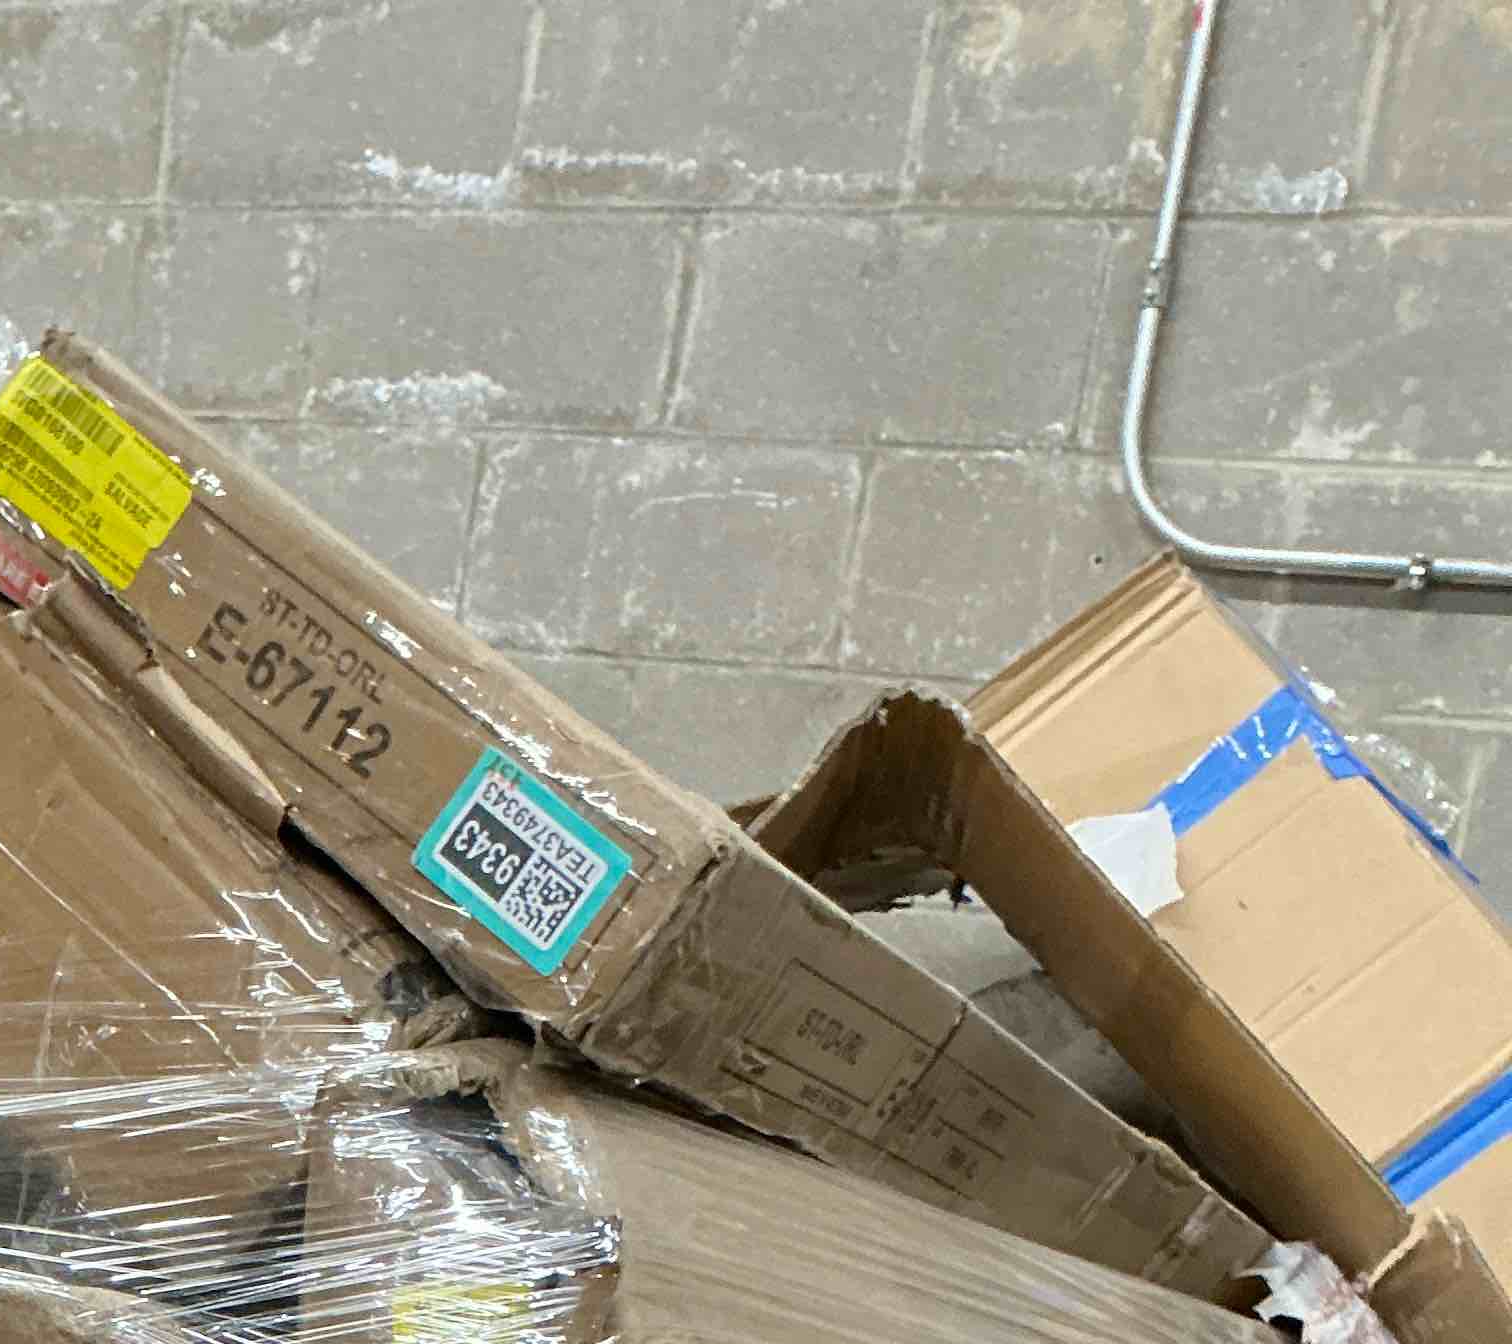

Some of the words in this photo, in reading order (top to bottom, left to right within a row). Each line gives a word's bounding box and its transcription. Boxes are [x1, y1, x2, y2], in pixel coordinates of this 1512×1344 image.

[195, 601, 392, 780] E-67112
[454, 819, 521, 886] 9343
[481, 780, 596, 885] TEA3749343
